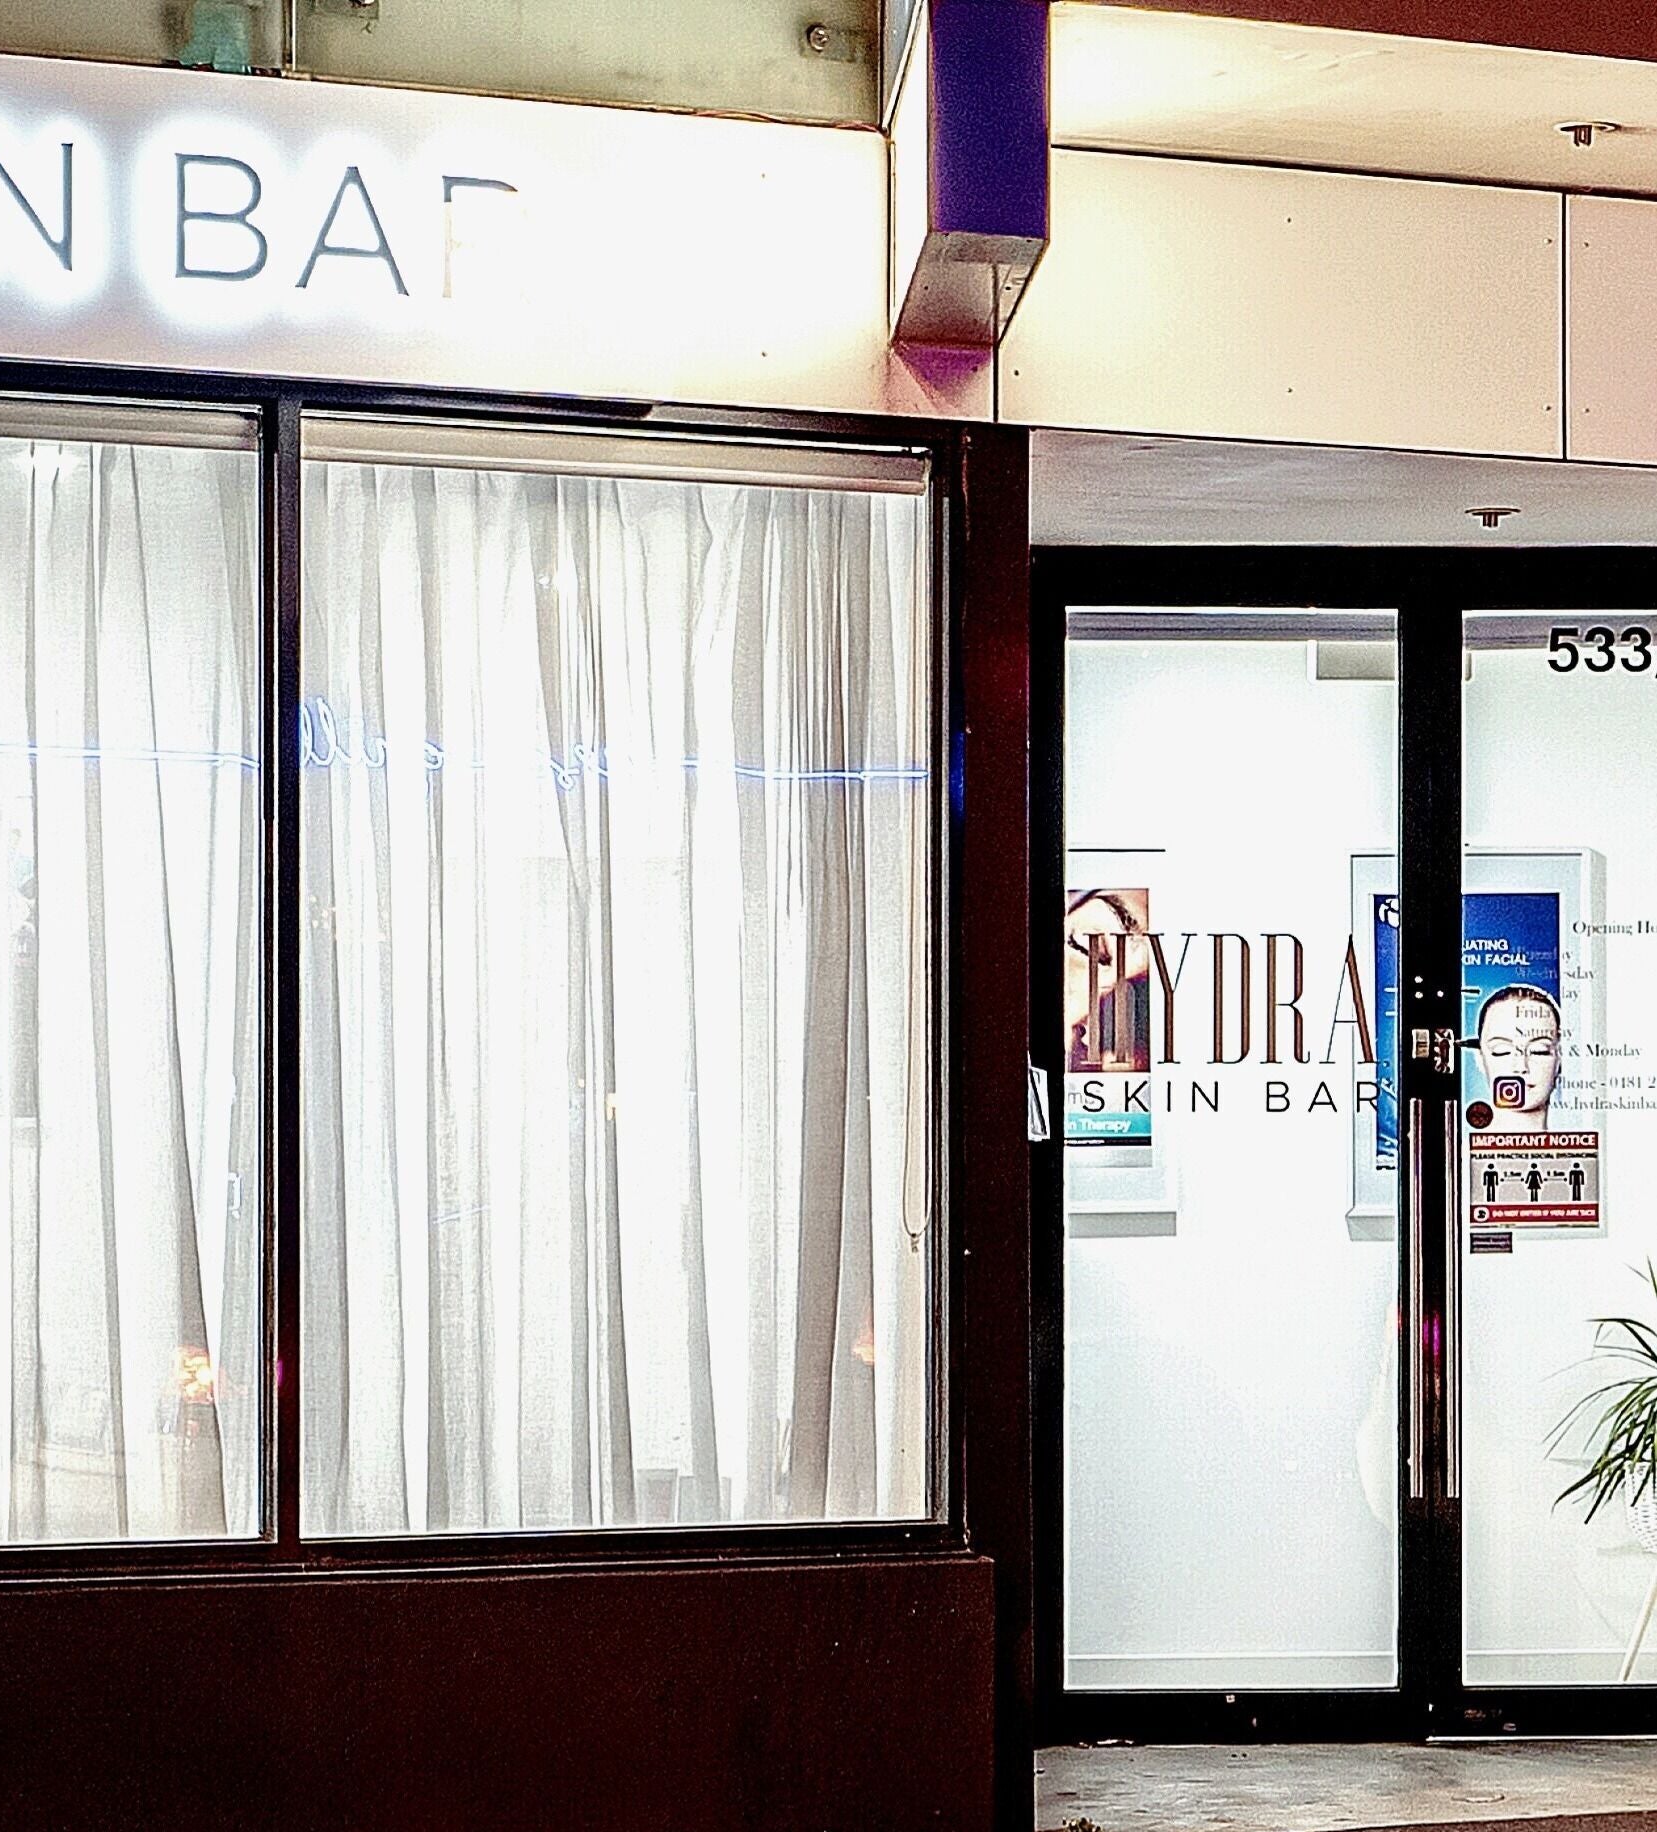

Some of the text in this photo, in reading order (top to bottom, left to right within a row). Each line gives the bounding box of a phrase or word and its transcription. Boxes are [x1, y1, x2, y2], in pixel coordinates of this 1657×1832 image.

[1547, 626, 1657, 679] 533
[1572, 919, 1634, 936] Opening
[1484, 953, 1531, 966] FACIAL
[1082, 932, 1380, 1065] HYDRA
[1515, 1005, 1553, 1019] Frida
[1568, 1043, 1581, 1058] &
[1585, 1043, 1643, 1061] Monday
[1082, 1080, 1219, 1113] SKIN
[1266, 1080, 1380, 1113] BAR
[1079, 1117, 1132, 1134] Therapy
[1472, 1134, 1596, 1147] IMPORTANT NOTICE
